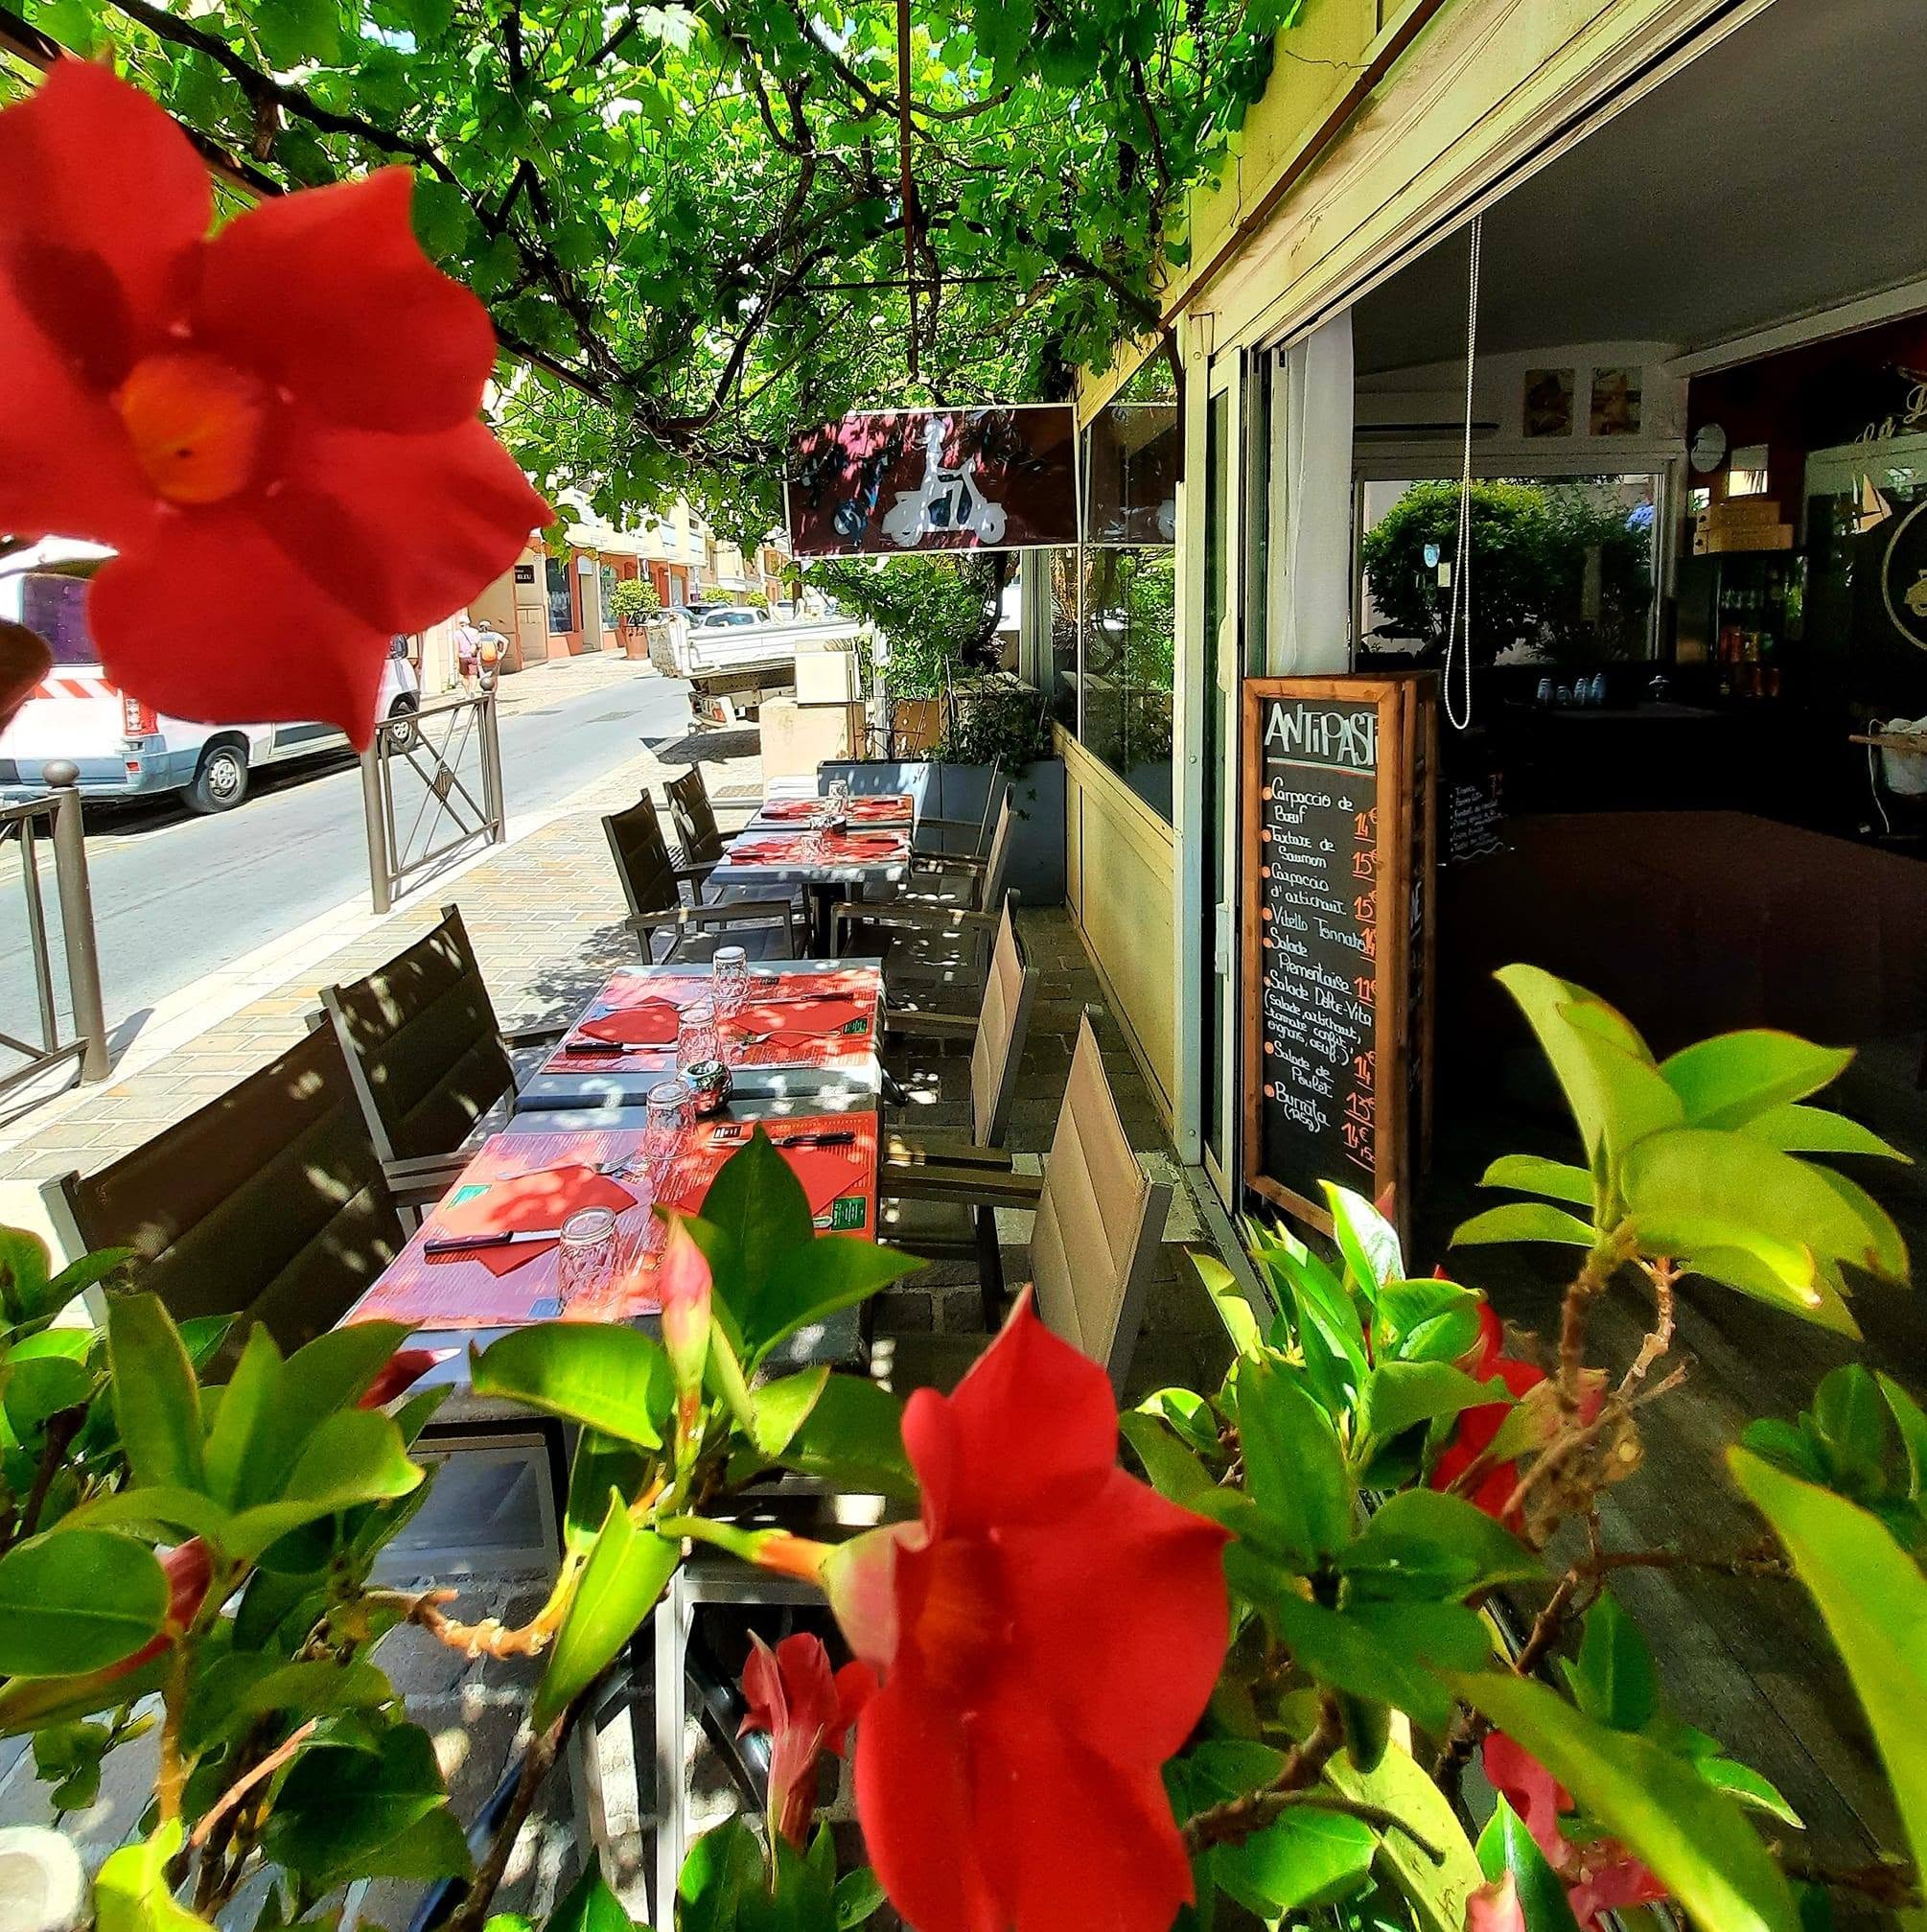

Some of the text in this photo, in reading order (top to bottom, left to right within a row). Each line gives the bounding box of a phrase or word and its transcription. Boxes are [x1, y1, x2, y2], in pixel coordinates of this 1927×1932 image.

[1271, 776, 1355, 813] Carpaccio de
[1278, 845, 1328, 869] Saumon
[1319, 837, 1336, 852] de
[1270, 902, 1309, 931] Vitello
[1270, 926, 1309, 958] Salade
[1270, 969, 1310, 1001] Salade
[1273, 1040, 1335, 1083] Salade de
[1290, 1066, 1334, 1099] Poulet
[1274, 1081, 1332, 1129] Burrata
